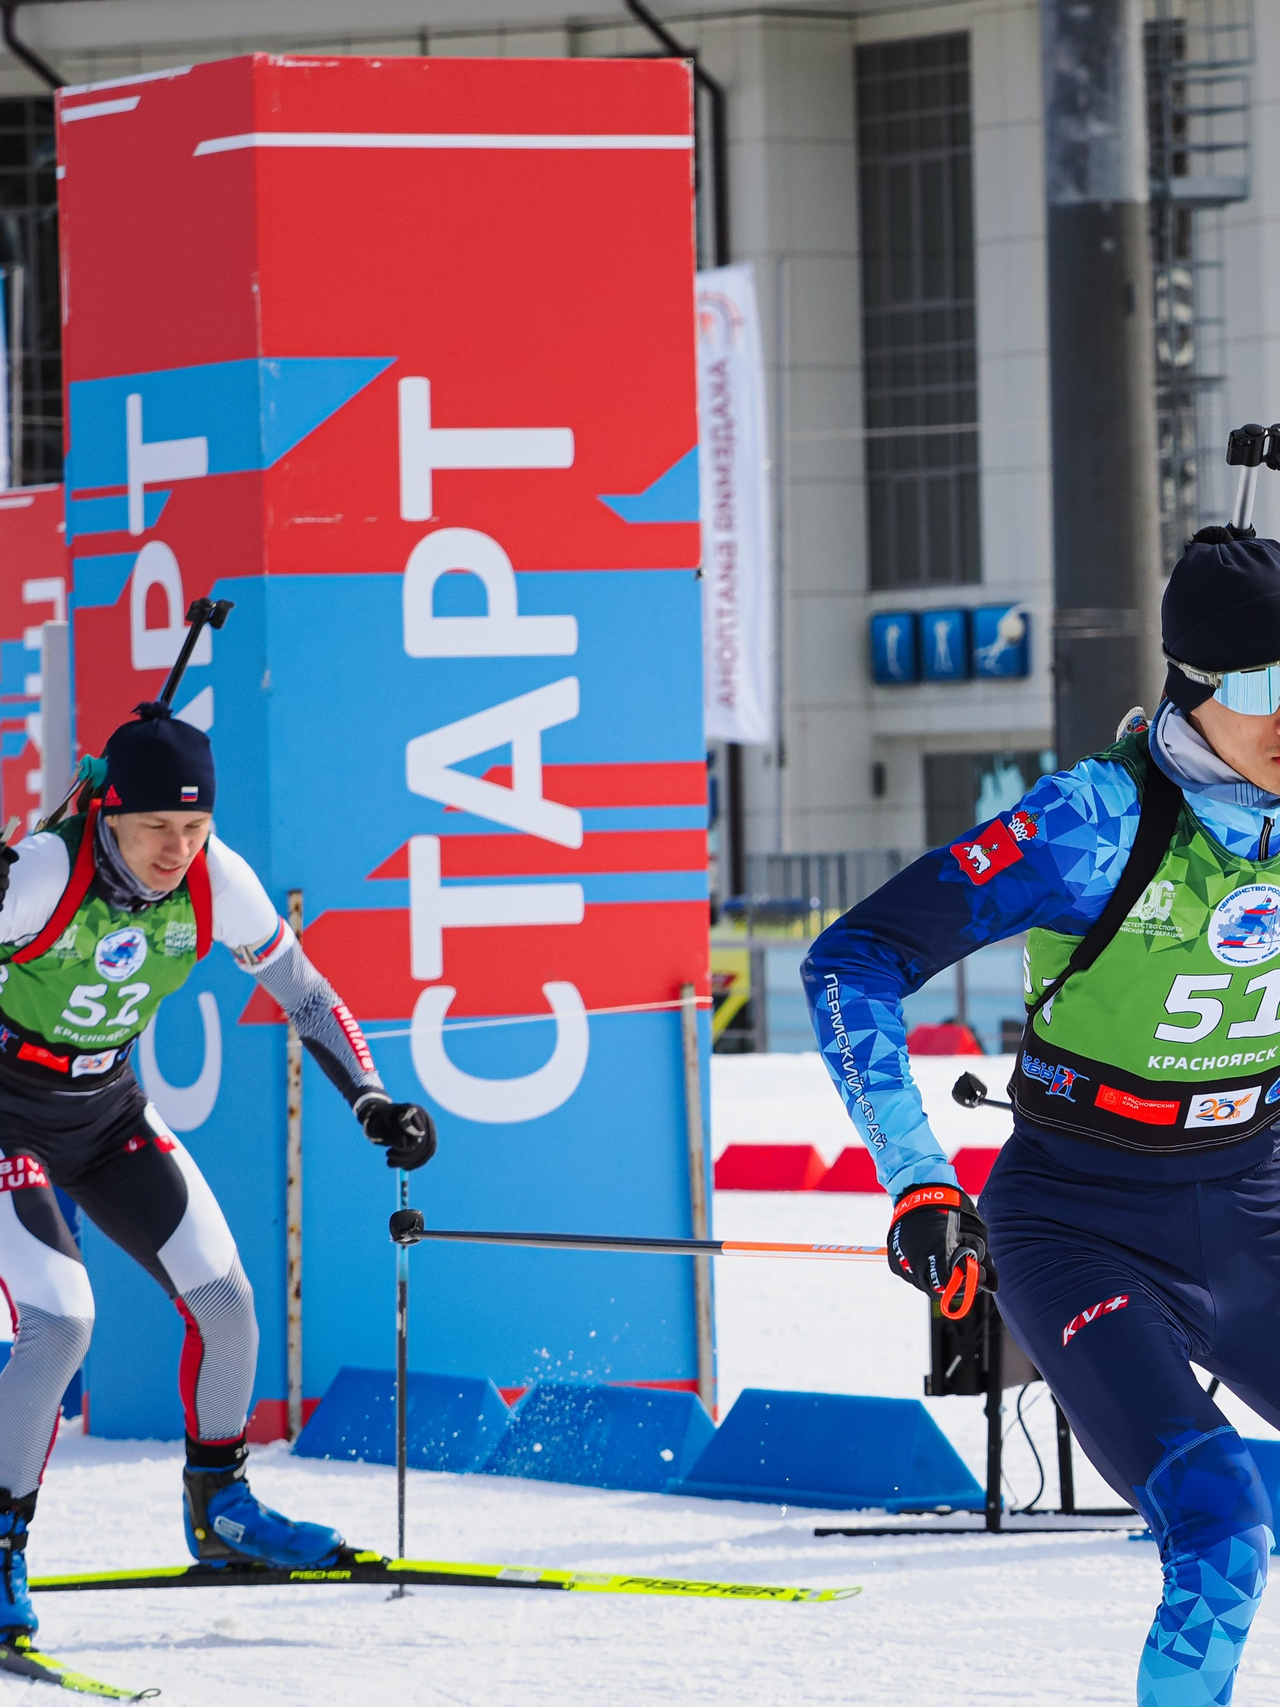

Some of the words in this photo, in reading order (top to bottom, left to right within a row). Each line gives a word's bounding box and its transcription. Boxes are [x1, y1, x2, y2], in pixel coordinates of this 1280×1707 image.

[126, 393, 222, 1132] СРТ
[399, 376, 590, 1124] СТАРТ
[1218, 885, 1267, 912] ПЕРВЕНСТВО
[61, 982, 151, 1028] 52
[823, 972, 866, 1096] ПЕРМСКИЙ
[855, 1093, 888, 1152] КРАЙ
[1147, 1045, 1279, 1071] КРАСНОЯРСК
[894, 1191, 945, 1216] ONE/WA
[289, 1569, 352, 1581] FISCHER
[619, 1577, 786, 1598] FISCHER
